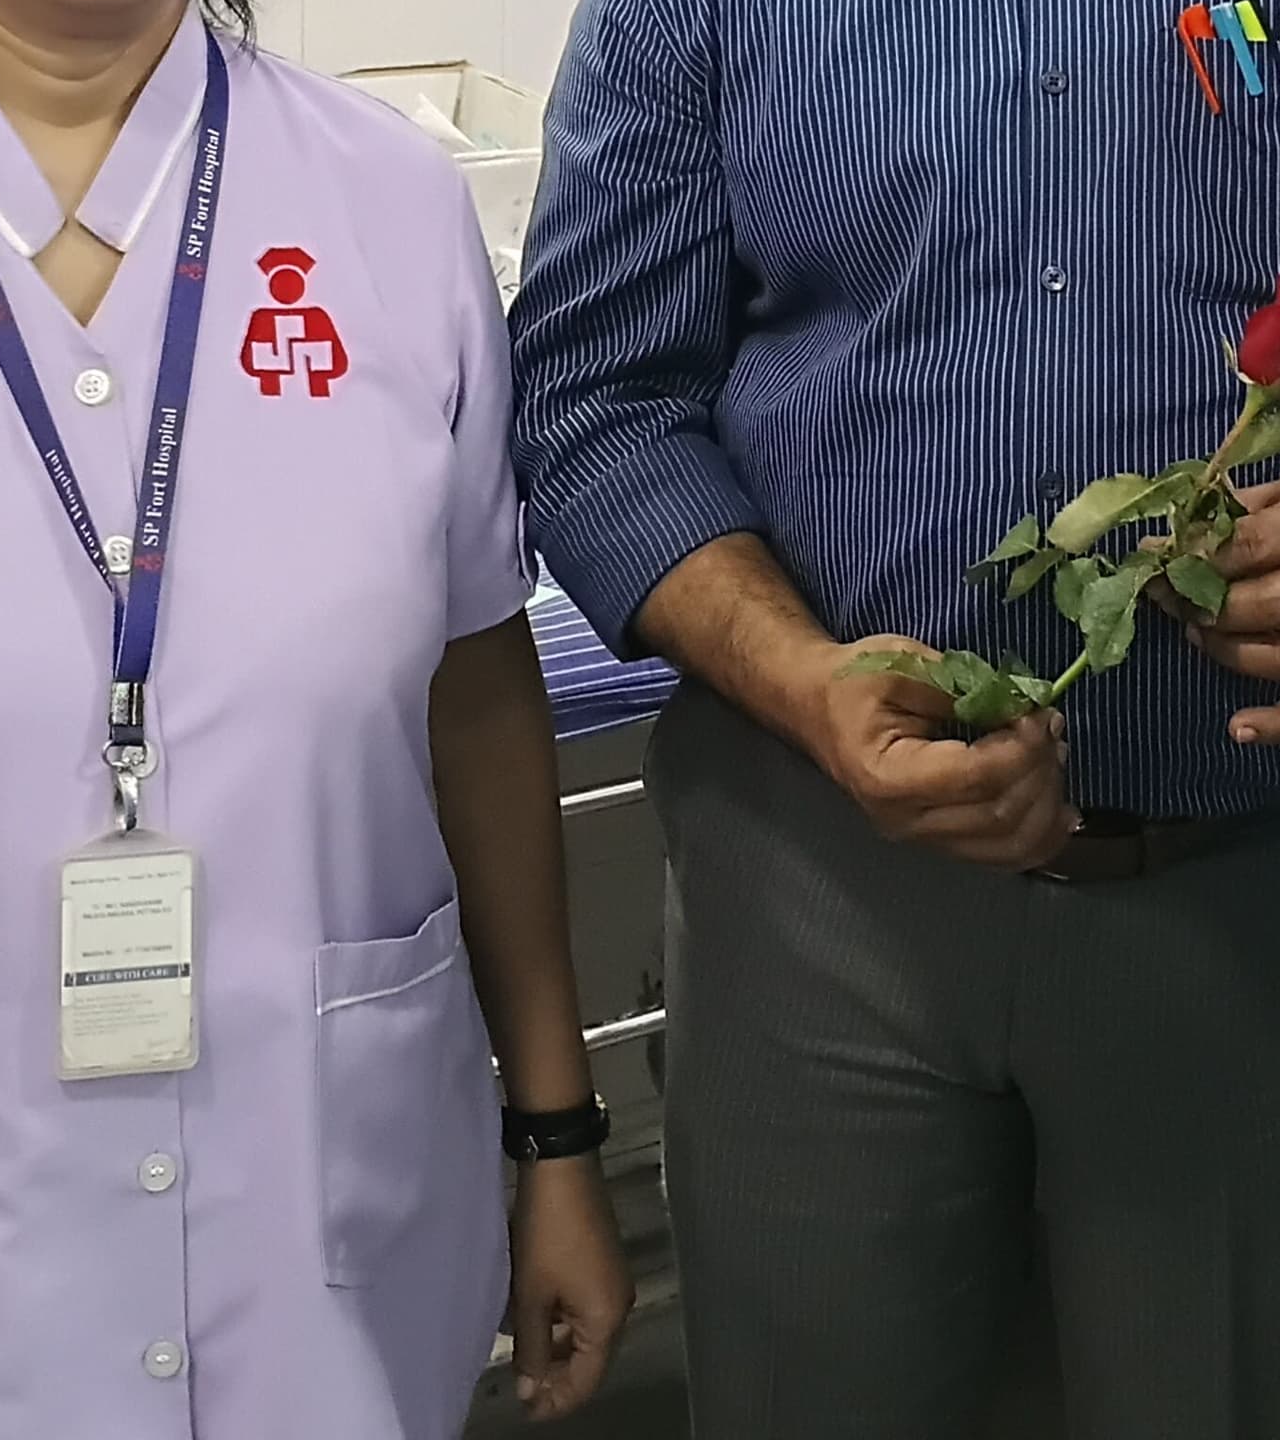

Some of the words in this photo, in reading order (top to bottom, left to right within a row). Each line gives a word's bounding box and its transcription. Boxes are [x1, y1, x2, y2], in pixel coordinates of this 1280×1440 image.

[197, 128, 221, 194] Hospital
[191, 196, 211, 232] Fort
[185, 233, 204, 259] SP
[151, 407, 178, 477] Hospital
[145, 481, 168, 518] Fort
[142, 521, 160, 547] SP
[113, 969, 140, 980] WITH
[142, 967, 170, 978] CARE
